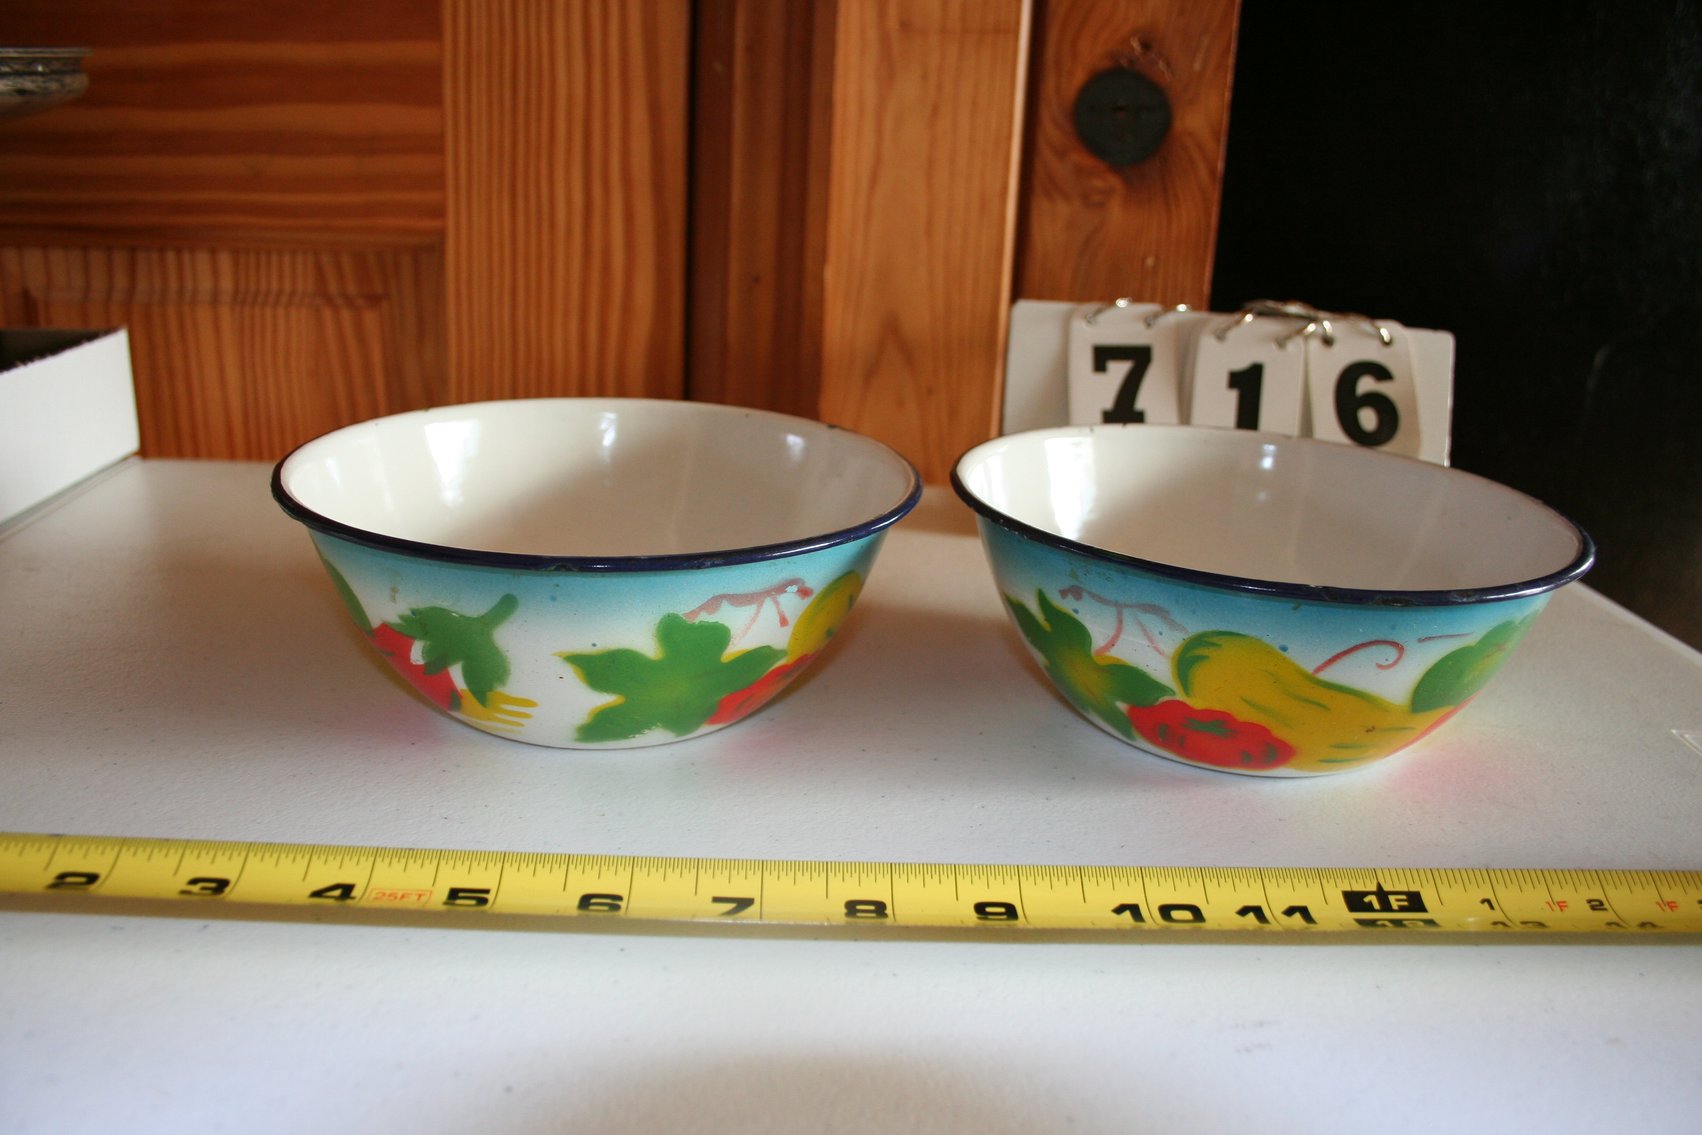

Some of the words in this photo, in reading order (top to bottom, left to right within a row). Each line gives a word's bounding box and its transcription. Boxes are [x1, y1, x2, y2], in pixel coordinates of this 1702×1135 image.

[1092, 344, 1152, 424] 7
[1227, 362, 1264, 431] 1
[1333, 360, 1400, 447] 6
[179, 876, 231, 897] 3
[308, 882, 357, 902] 4
[442, 887, 491, 908] 5
[576, 892, 624, 913] 6
[711, 896, 755, 916] 7
[843, 899, 890, 919] 8
[972, 901, 1019, 921] 9
[1111, 903, 1206, 924] 10
[1235, 904, 1317, 925] 11
[1480, 898, 1495, 911] 1
[1586, 898, 1608, 911] 2
